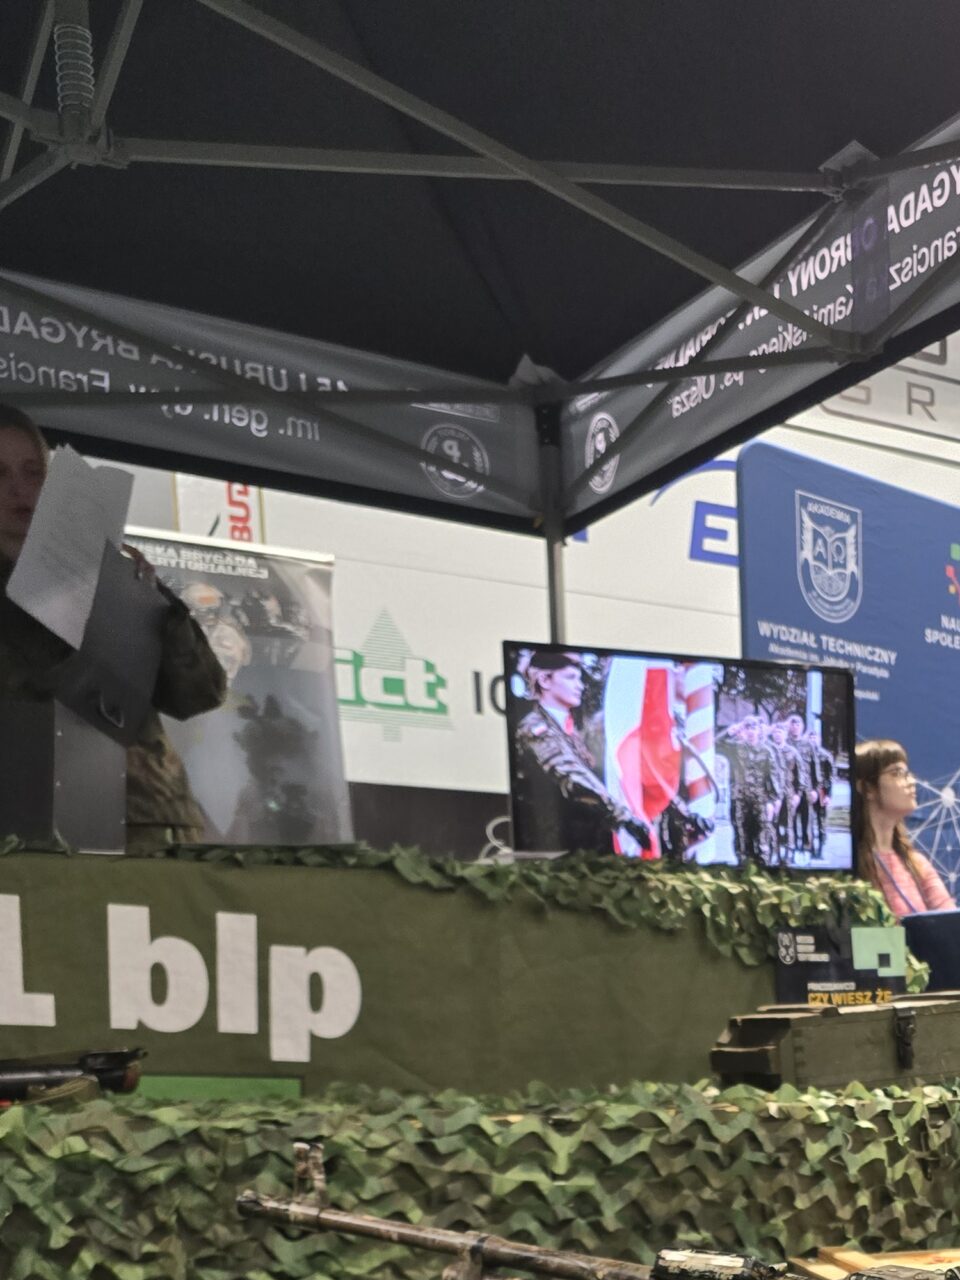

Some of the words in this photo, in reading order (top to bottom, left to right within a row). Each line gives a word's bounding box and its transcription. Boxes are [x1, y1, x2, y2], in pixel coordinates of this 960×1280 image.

[148, 554, 269, 580] ERYTORIALNEJ
[757, 620, 818, 649] WYDZIAŁ
[820, 634, 898, 666] TECHNICZNY
[107, 902, 363, 1063] blp
[830, 990, 873, 1006] WIESZ
